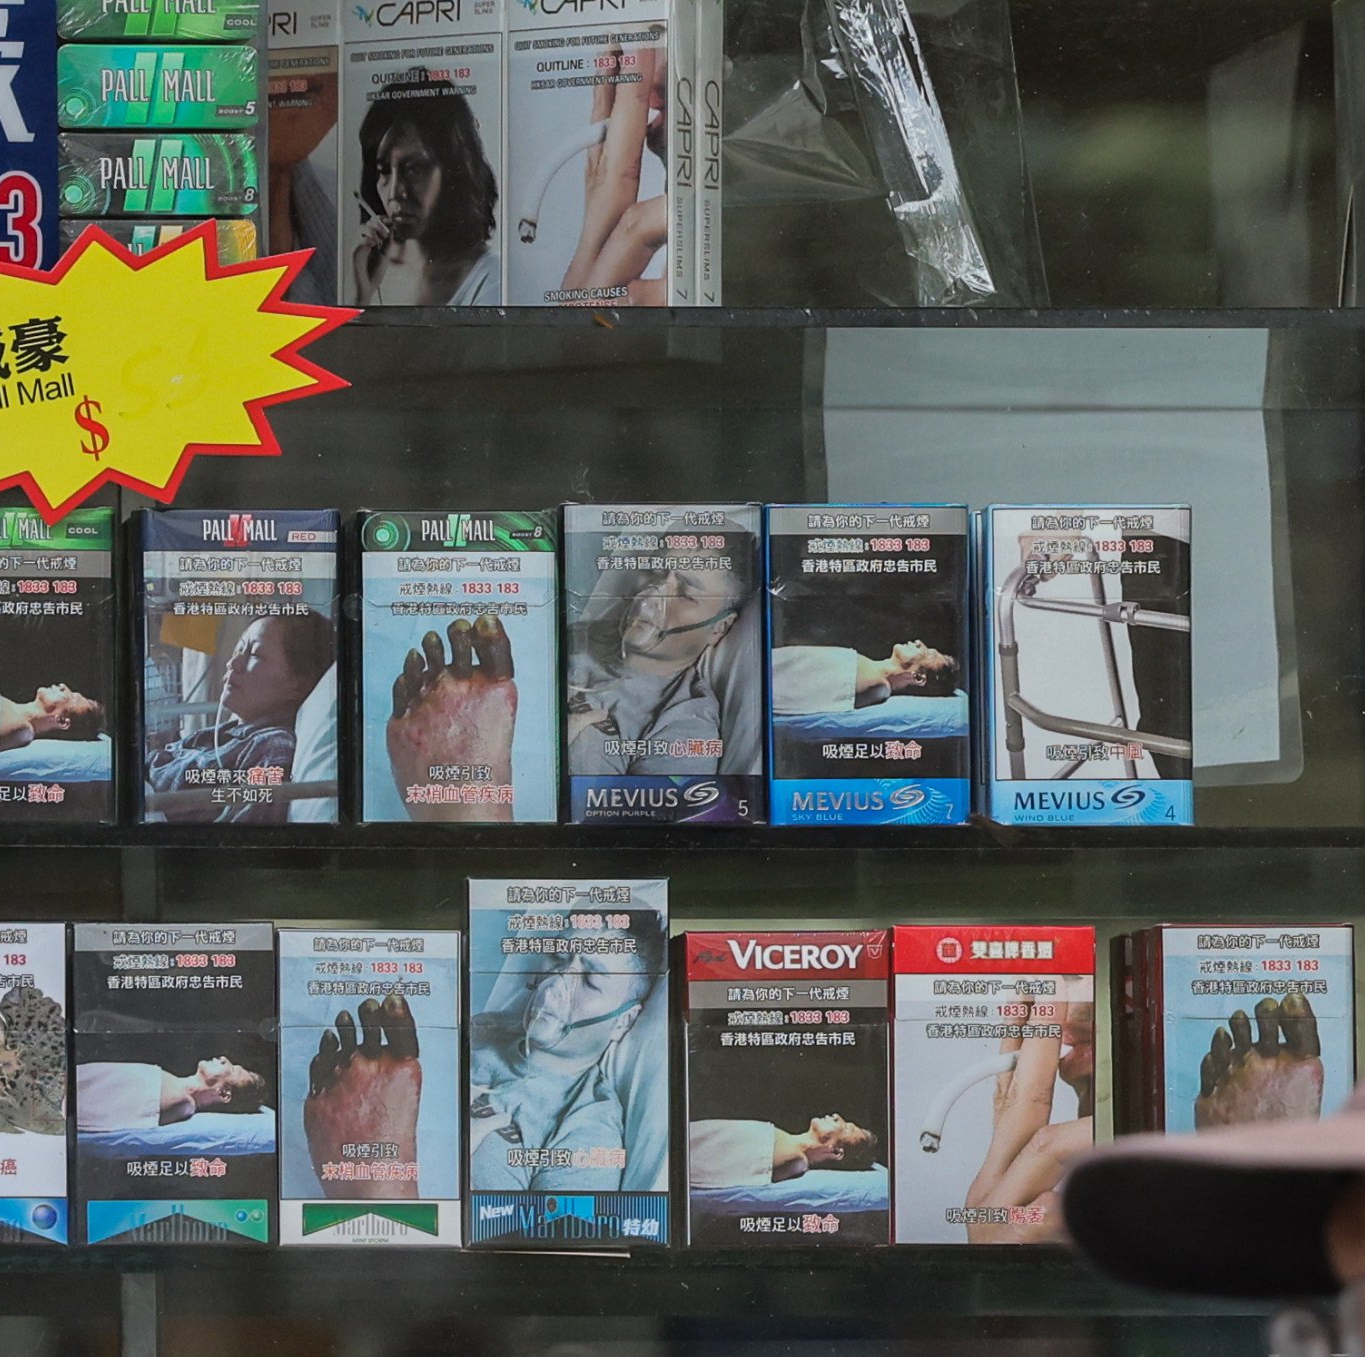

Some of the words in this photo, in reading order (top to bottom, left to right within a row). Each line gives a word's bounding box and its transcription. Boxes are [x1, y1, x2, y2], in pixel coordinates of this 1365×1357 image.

[376, 0, 461, 27] CAPRI
[536, 59, 583, 72] QUITLINE
[593, 56, 616, 68] 1833
[619, 55, 636, 67] 183
[101, 67, 149, 103] PALL
[163, 67, 216, 103] MALL
[677, 78, 693, 189] CAPRI
[99, 156, 149, 190] PALL
[162, 156, 214, 190] MALL
[543, 289, 586, 302] SMOKING
[589, 286, 627, 299] CAUSES
[16, 373, 76, 409] Mall
[74, 394, 110, 461] $
[18, 517, 53, 540] MALL
[68, 526, 99, 536] COOL
[203, 519, 235, 542] PALL
[243, 519, 278, 542] MALL
[291, 532, 316, 542] RED
[422, 520, 453, 543] PALL
[461, 520, 496, 543] MALL
[585, 787, 679, 811] MEVIUS
[738, 800, 748, 818] 5
[792, 790, 885, 814] MEVIUS
[1014, 789, 1105, 812] MEVIUS
[1165, 805, 1176, 821] 4
[3, 954, 27, 967] 183
[727, 940, 863, 970] VICEROY
[480, 1204, 514, 1220] New
